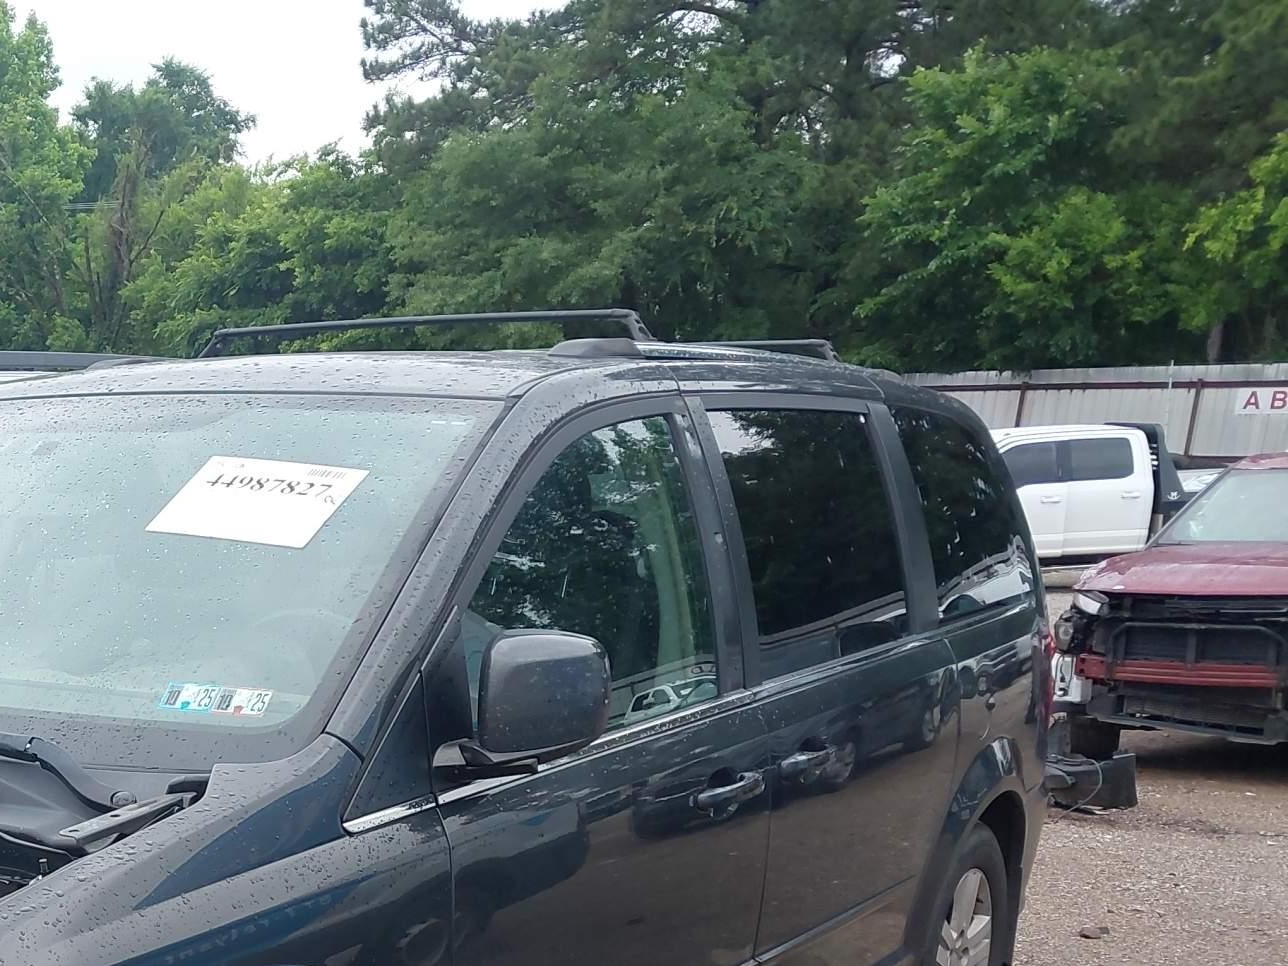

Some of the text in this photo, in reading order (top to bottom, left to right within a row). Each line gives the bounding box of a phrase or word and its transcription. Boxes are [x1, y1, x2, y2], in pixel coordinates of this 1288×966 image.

[1242, 391, 1288, 410] A B
[206, 474, 333, 497] 44987827
[198, 688, 216, 708] 25
[251, 693, 271, 712] 25
